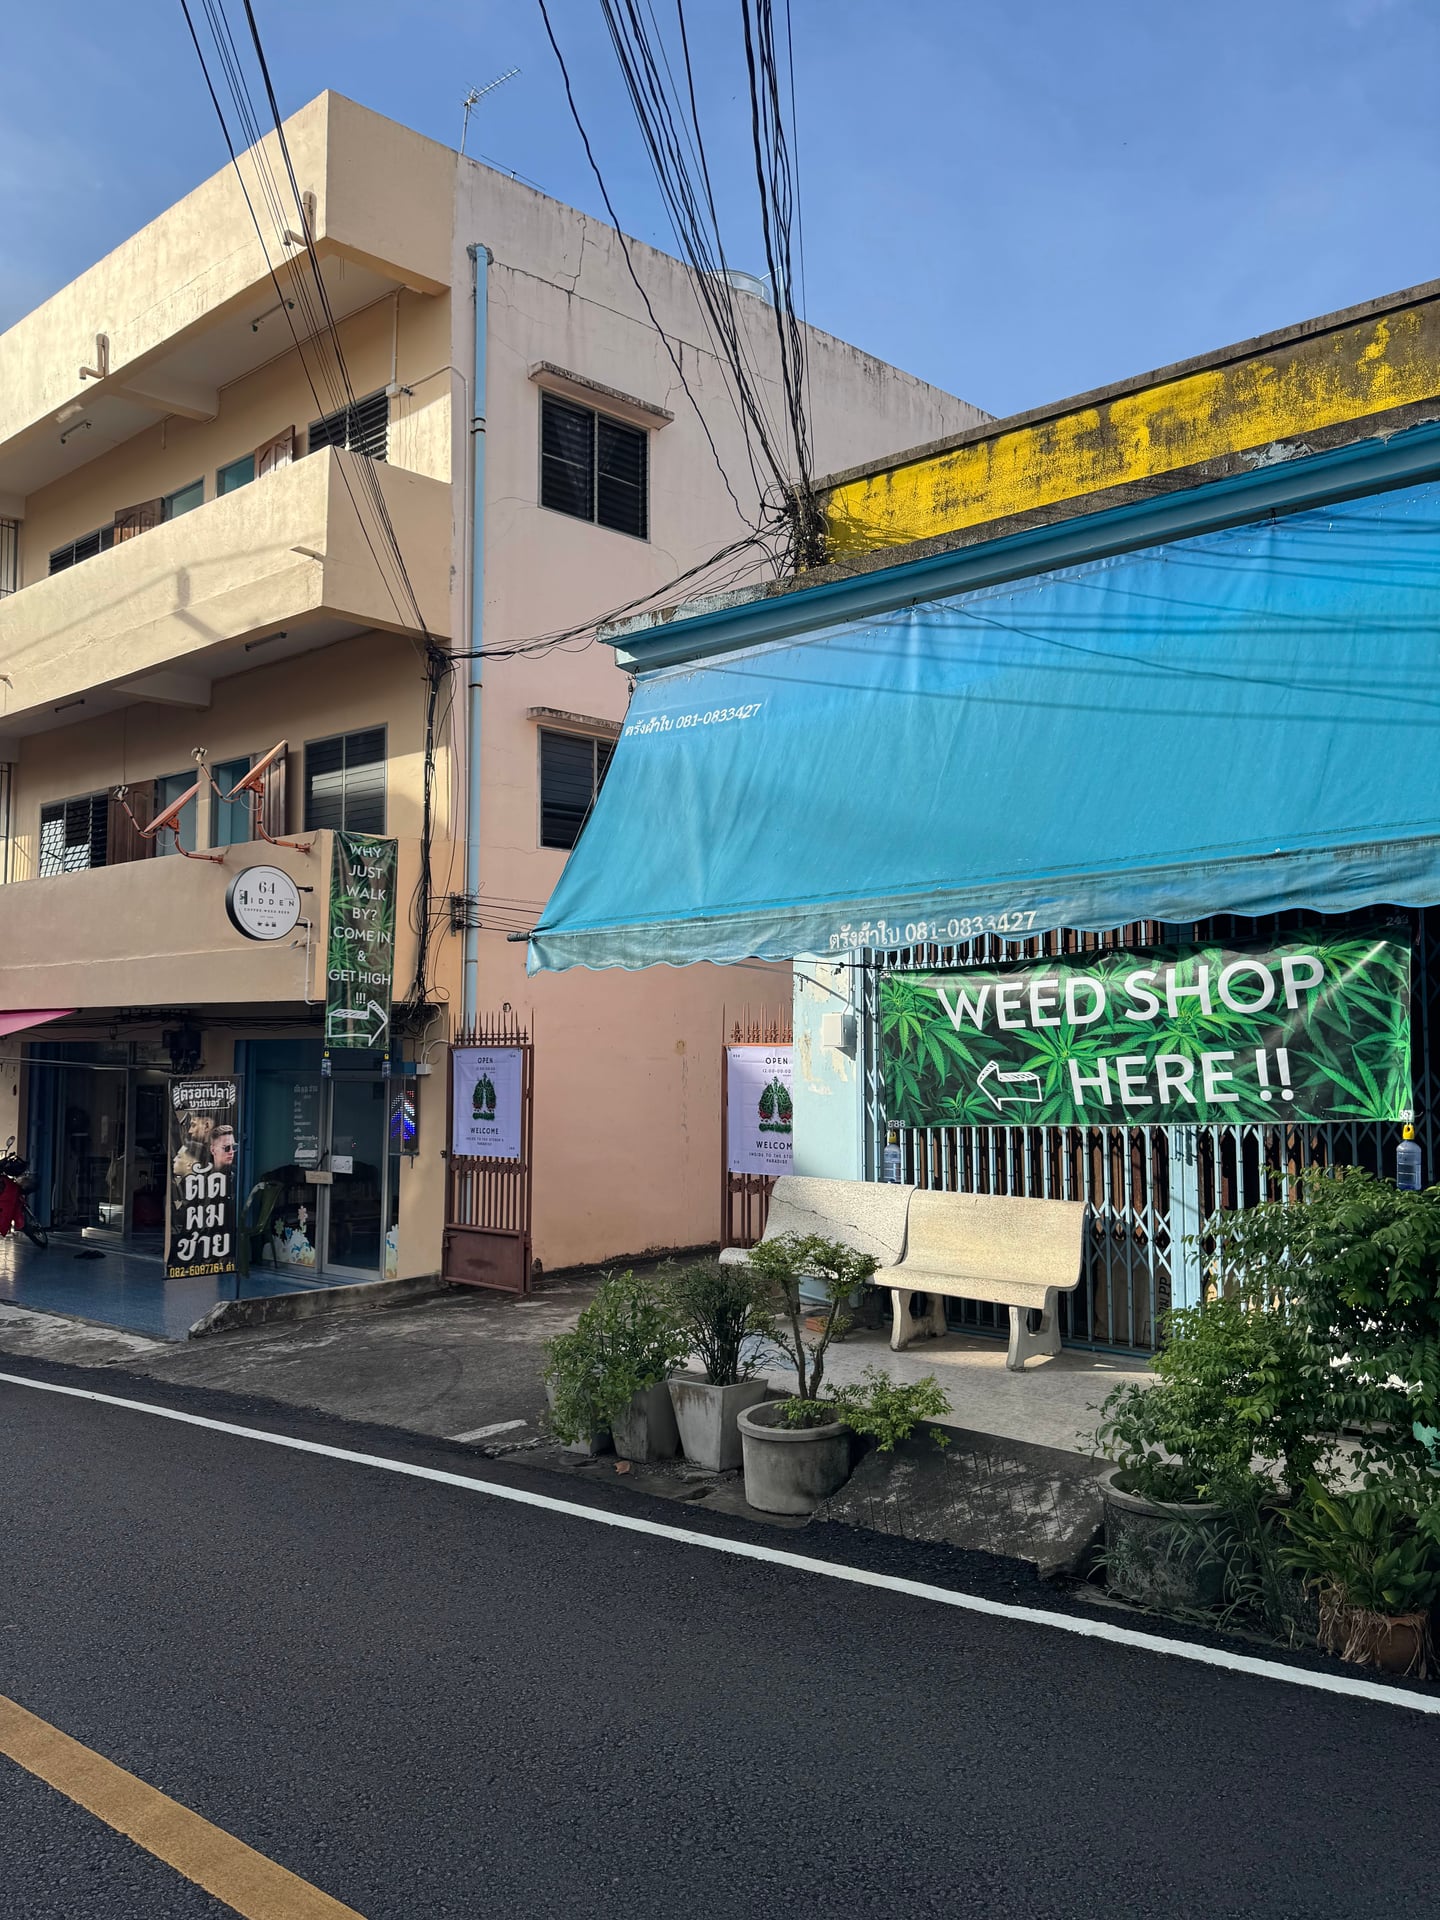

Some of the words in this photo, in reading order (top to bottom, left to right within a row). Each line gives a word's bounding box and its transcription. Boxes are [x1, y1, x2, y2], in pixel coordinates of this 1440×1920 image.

[676, 703, 762, 729] 081-0833427
[349, 843, 382, 858] WHY
[348, 864, 383, 879] JUST
[259, 881, 275, 895] 64
[346, 885, 387, 901] WALK
[352, 907, 377, 921] BY?
[333, 926, 375, 942] COME
[377, 931, 391, 944] IN
[829, 919, 900, 950] ตรังผ้าใบ
[905, 910, 1038, 943] 081-0833427
[357, 950, 366, 962] &
[328, 969, 357, 982] GET
[358, 971, 391, 986] HIGH
[355, 992, 366, 1004] !!!
[936, 976, 1105, 1032] WEED
[1124, 954, 1325, 1022] SHOP
[765, 1057, 788, 1065] OPEN
[1069, 1050, 1240, 1106] HERE
[1254, 1047, 1295, 1101] !!
[470, 1127, 499, 1135] WELCOME
[756, 1141, 793, 1150] WELCOM
[185, 1162, 227, 1201] ตัด
[186, 1203, 225, 1231] ผม
[177, 1231, 231, 1261] ชาย
